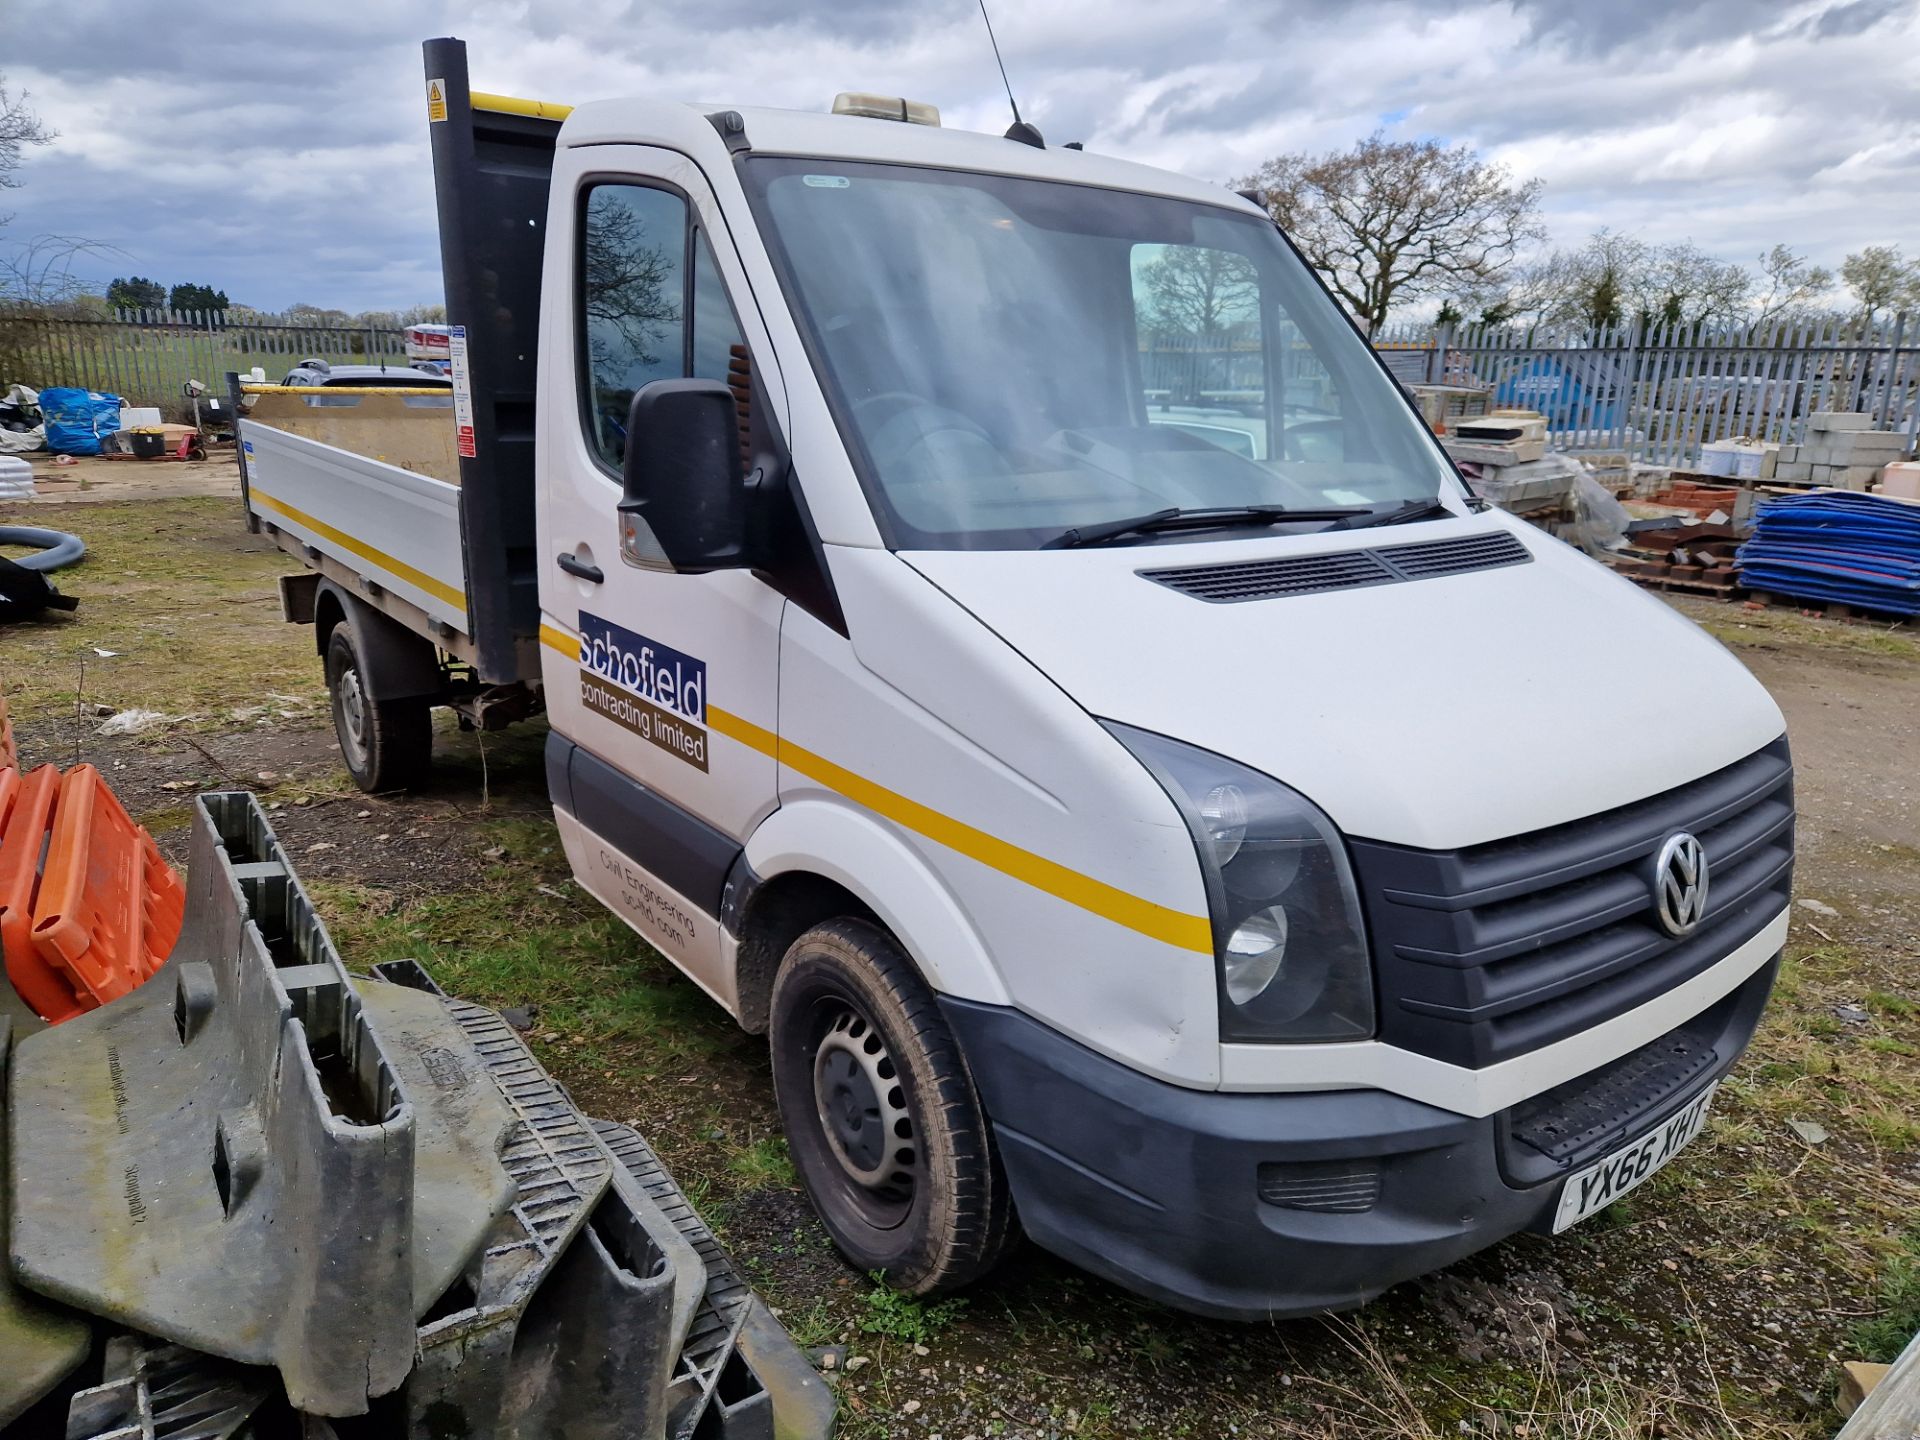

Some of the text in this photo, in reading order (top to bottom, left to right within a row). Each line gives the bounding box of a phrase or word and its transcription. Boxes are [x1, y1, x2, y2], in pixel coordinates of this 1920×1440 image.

[580, 631, 702, 722] schofield
[581, 680, 704, 762] contracting limited
[600, 850, 695, 938] Civil Engineering
[621, 890, 685, 949] sc-ltdcom
[1578, 1094, 1709, 1215] YX66 XHT
